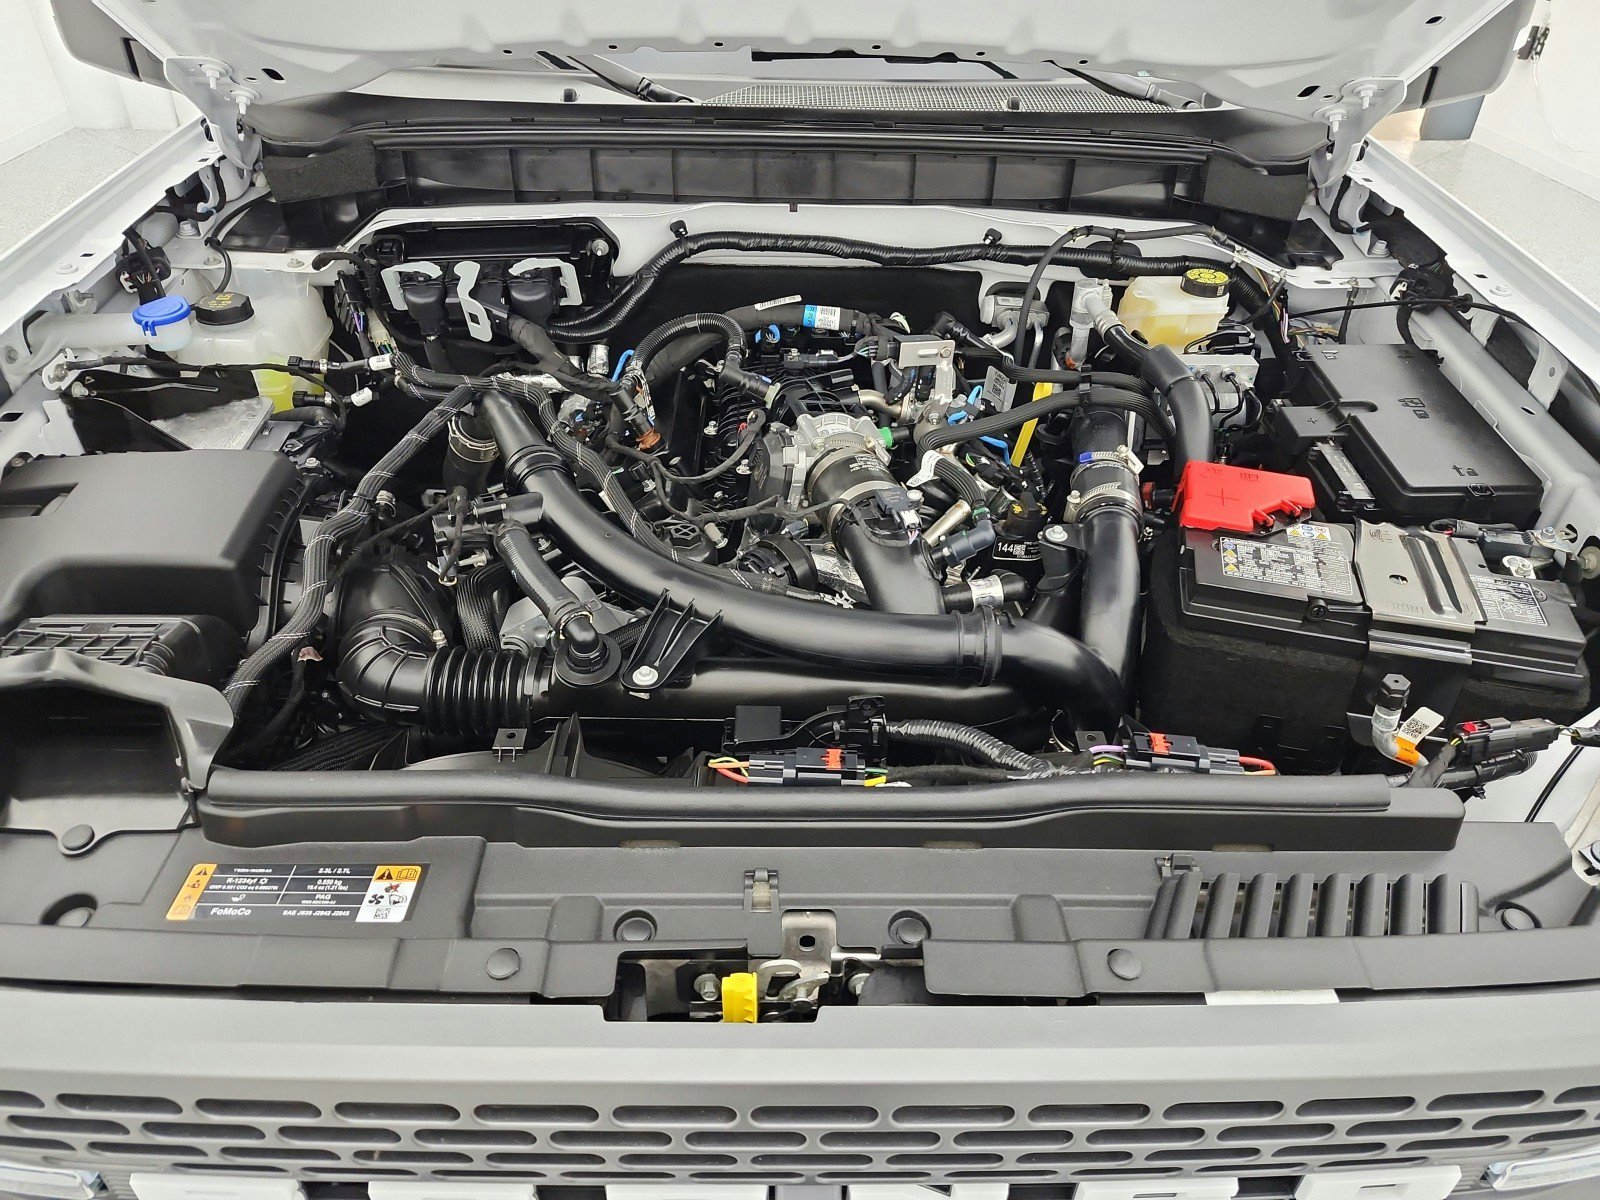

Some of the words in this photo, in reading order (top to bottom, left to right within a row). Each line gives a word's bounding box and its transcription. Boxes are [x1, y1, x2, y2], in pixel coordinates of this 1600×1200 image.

[997, 542, 1014, 552] 144
[226, 877, 258, 885] R-1234yf
[210, 907, 252, 916] FoMoCo
